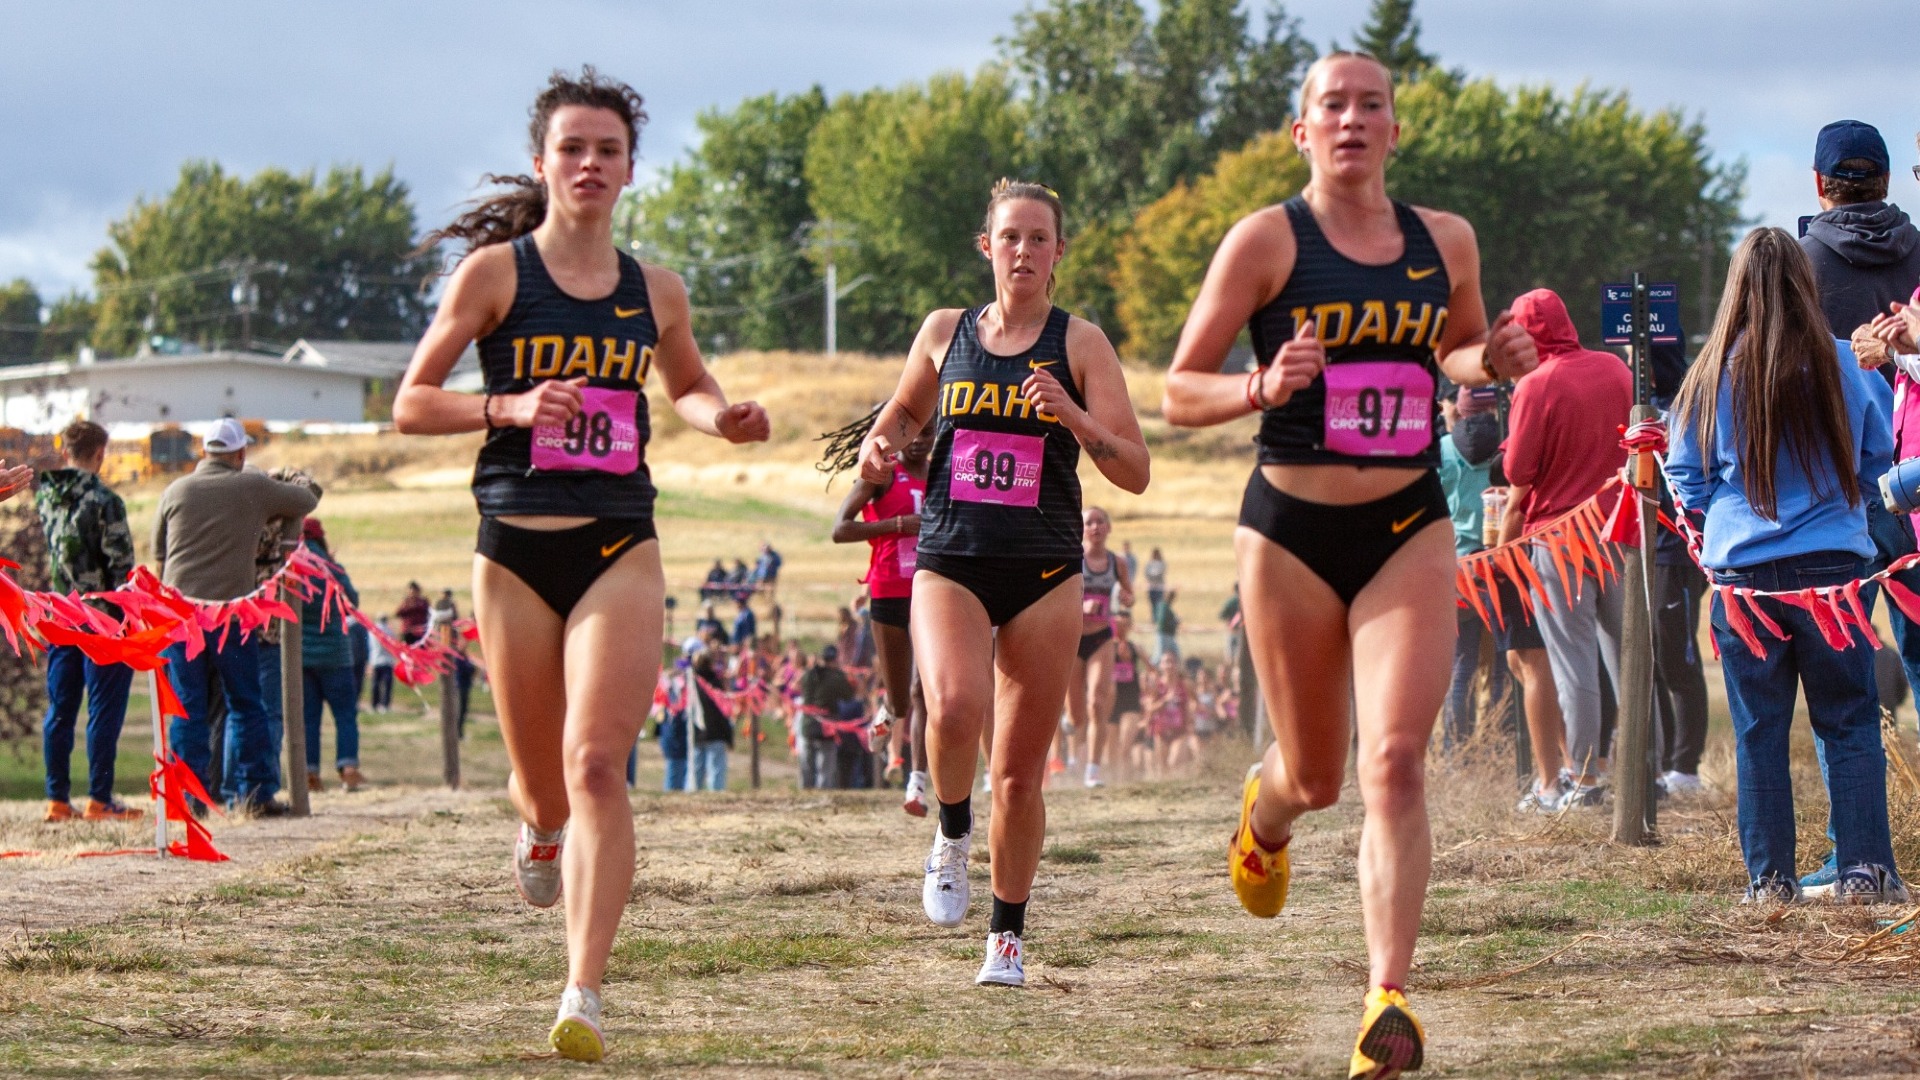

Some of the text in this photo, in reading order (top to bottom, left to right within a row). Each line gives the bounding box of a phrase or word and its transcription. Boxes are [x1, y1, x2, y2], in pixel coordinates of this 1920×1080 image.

[564, 410, 613, 457] 98
[1359, 387, 1404, 438] 97
[974, 450, 1015, 492] 99
